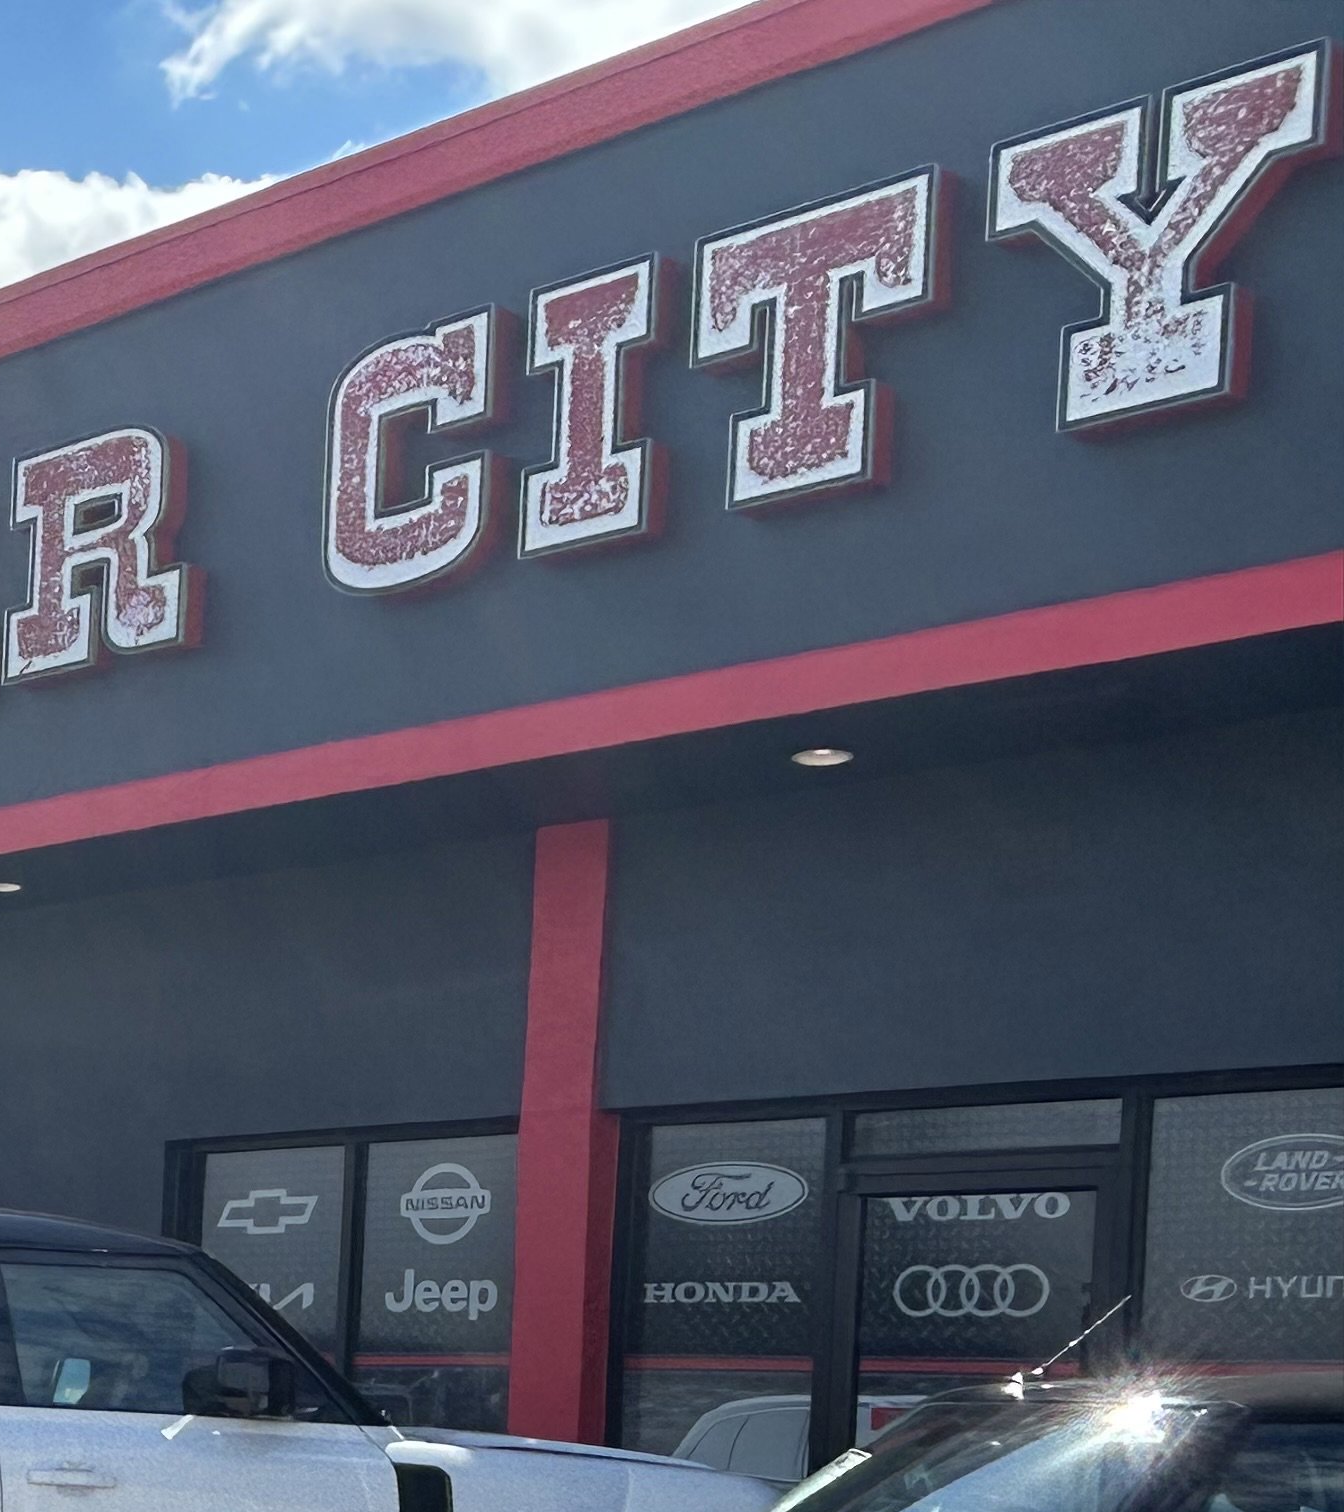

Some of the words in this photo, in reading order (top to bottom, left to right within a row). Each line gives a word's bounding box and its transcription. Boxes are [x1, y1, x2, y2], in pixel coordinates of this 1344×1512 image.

[323, 38, 1330, 593] CITY
[405, 1195, 486, 1211] NISSAN
[681, 1173, 775, 1211] Ford
[887, 1192, 1071, 1222] VOLVO
[385, 1268, 498, 1321] Jeep
[643, 1281, 802, 1303] HONDA
